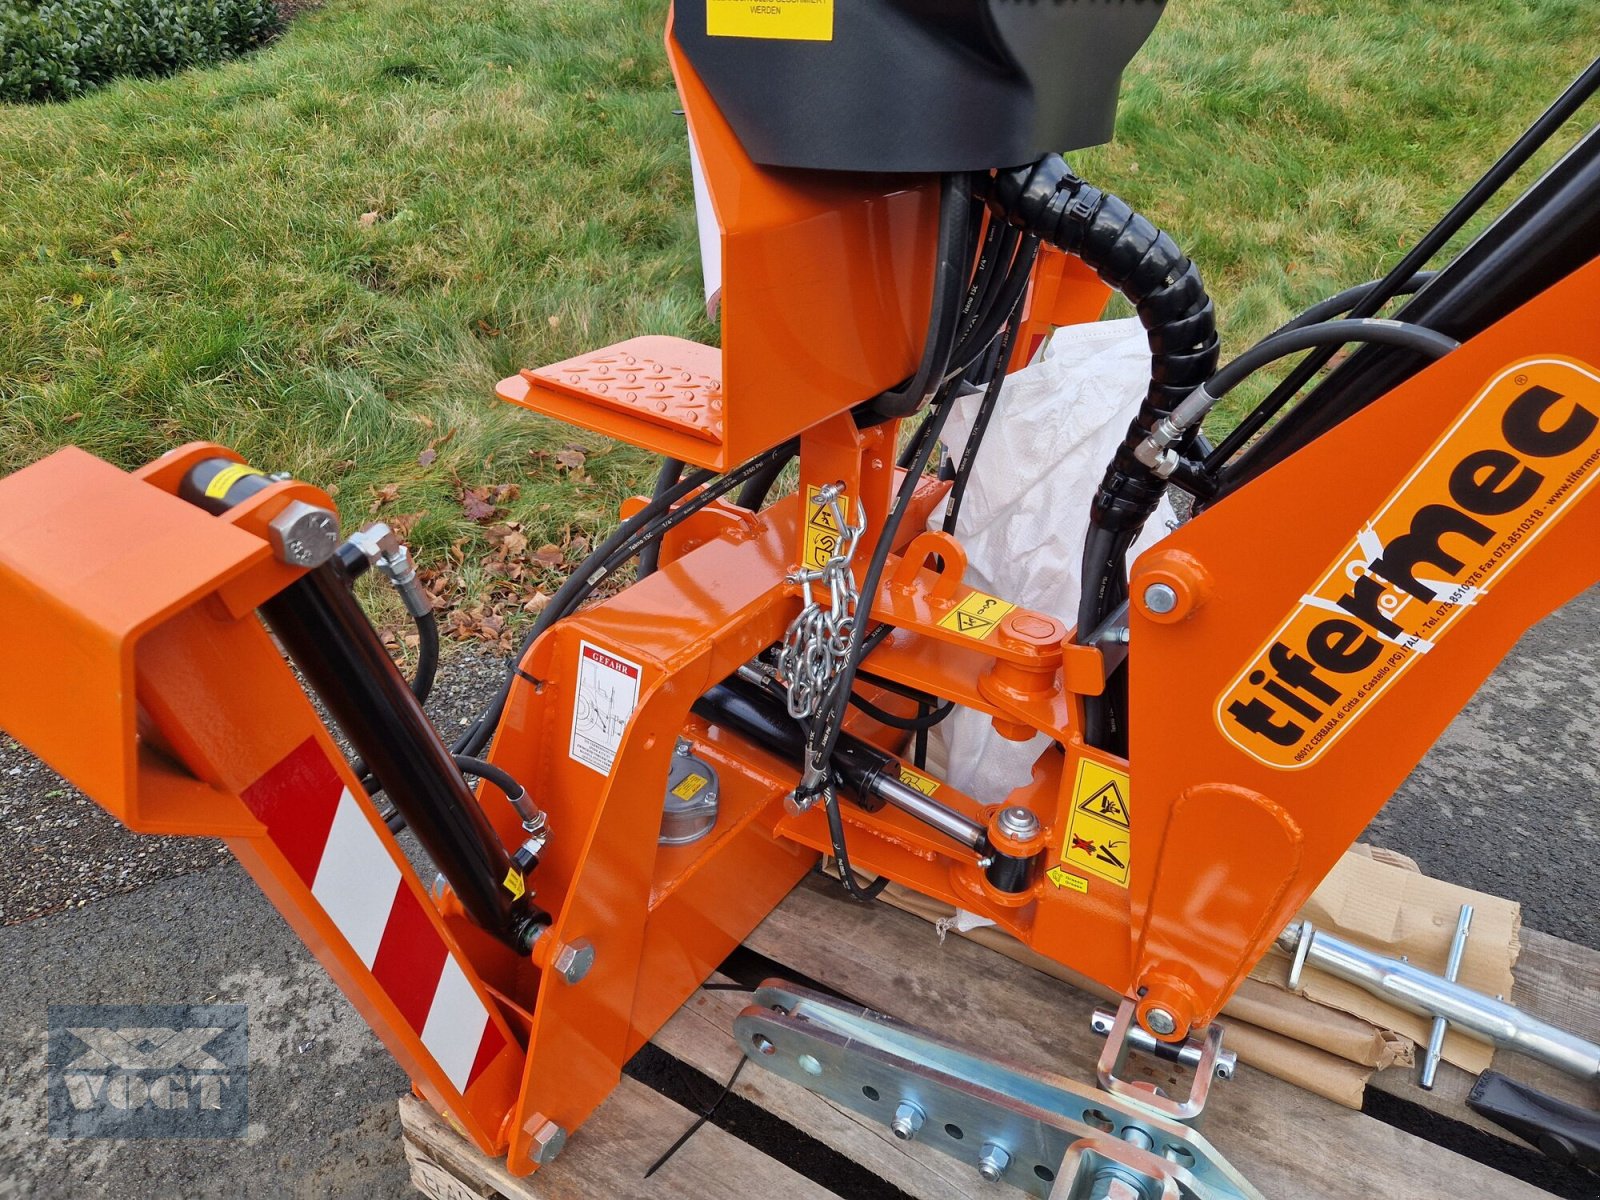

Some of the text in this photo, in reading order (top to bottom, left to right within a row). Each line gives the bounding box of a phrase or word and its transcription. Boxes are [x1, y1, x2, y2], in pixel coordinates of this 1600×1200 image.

[750, 6, 781, 14] WERDEN
[628, 537, 644, 551] Tekno
[742, 466, 755, 477] 3260
[1227, 384, 1599, 747] tifermec
[592, 652, 628, 674] GEFAHR
[1293, 742, 1313, 762] 06012
[1309, 716, 1339, 746] CERBARA
[1335, 710, 1345, 720] di
[1355, 688, 1366, 698] di
[1362, 663, 1390, 692] Castello
[1386, 649, 1405, 668] (PG)
[1400, 631, 1422, 653] ITALY
[1422, 613, 1439, 631] Tel.
[1435, 568, 1482, 618] 075.8510376
[1478, 555, 1496, 573] Fax
[1492, 505, 1544, 560] 075.8510318
